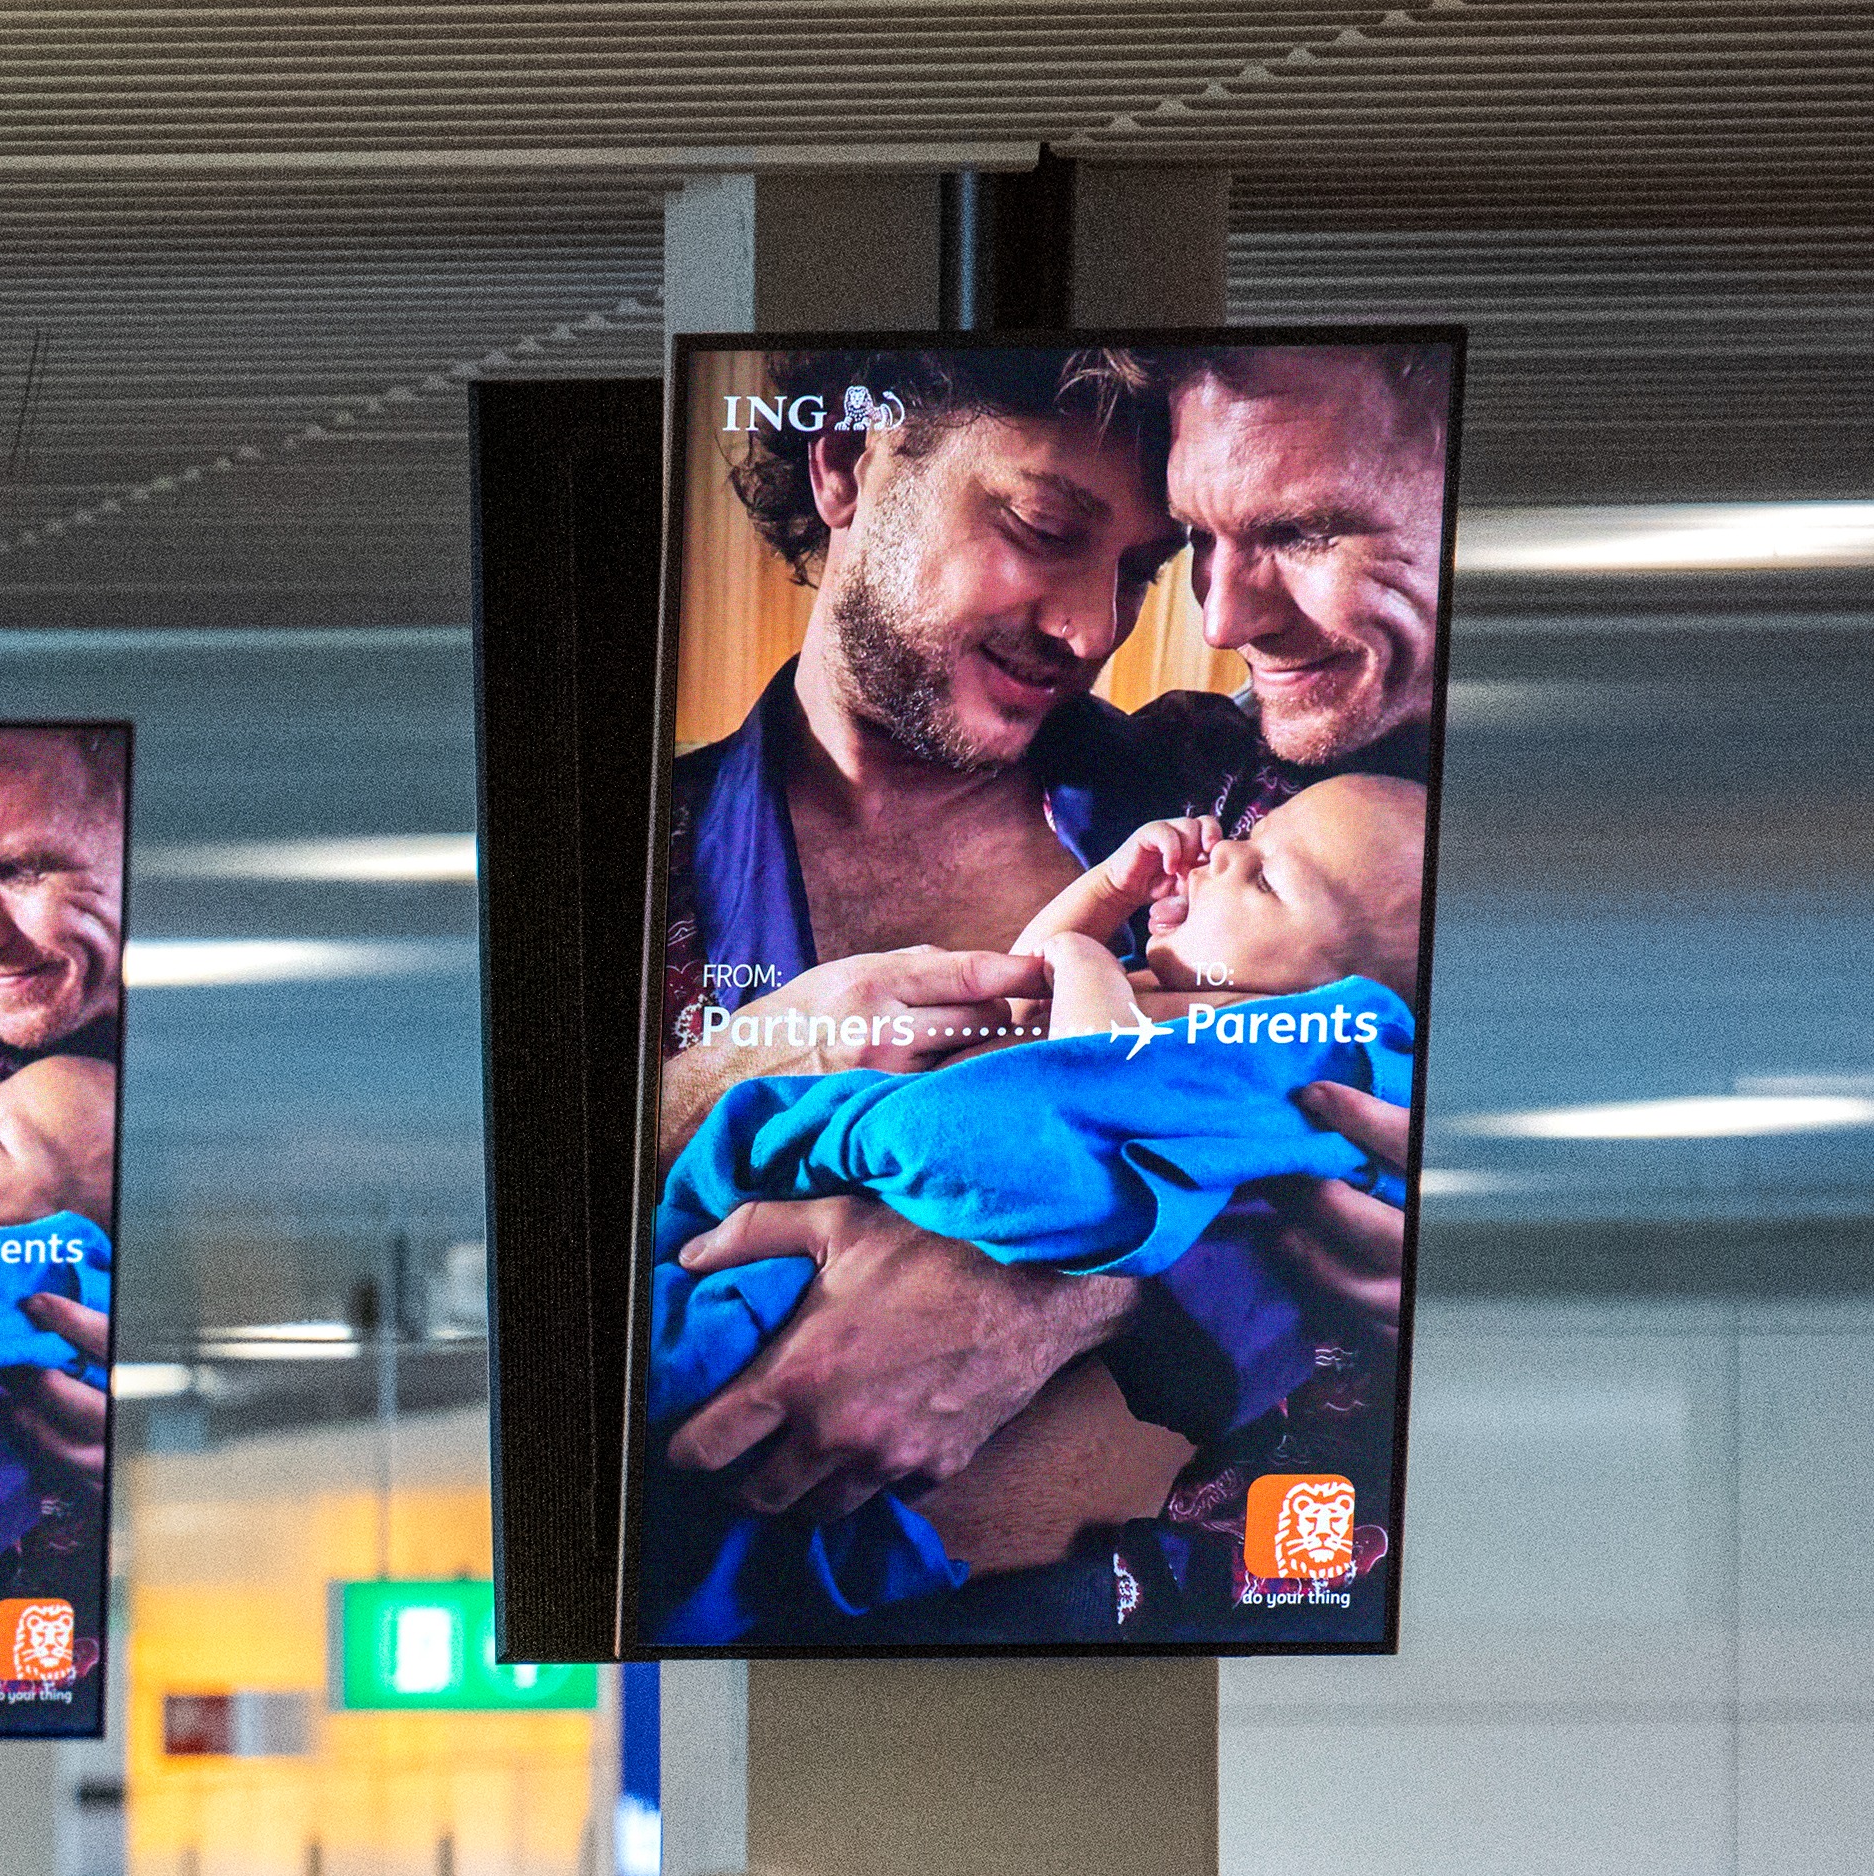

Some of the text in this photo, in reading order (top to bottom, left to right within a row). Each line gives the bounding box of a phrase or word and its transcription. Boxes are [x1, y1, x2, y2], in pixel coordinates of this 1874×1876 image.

[722, 394, 828, 432] ING
[703, 961, 1236, 988] FROM: TO:
[702, 1003, 1378, 1048] Partners Parents
[1242, 1589, 1351, 1609] do your thing
[40, 1688, 73, 1704] thing
